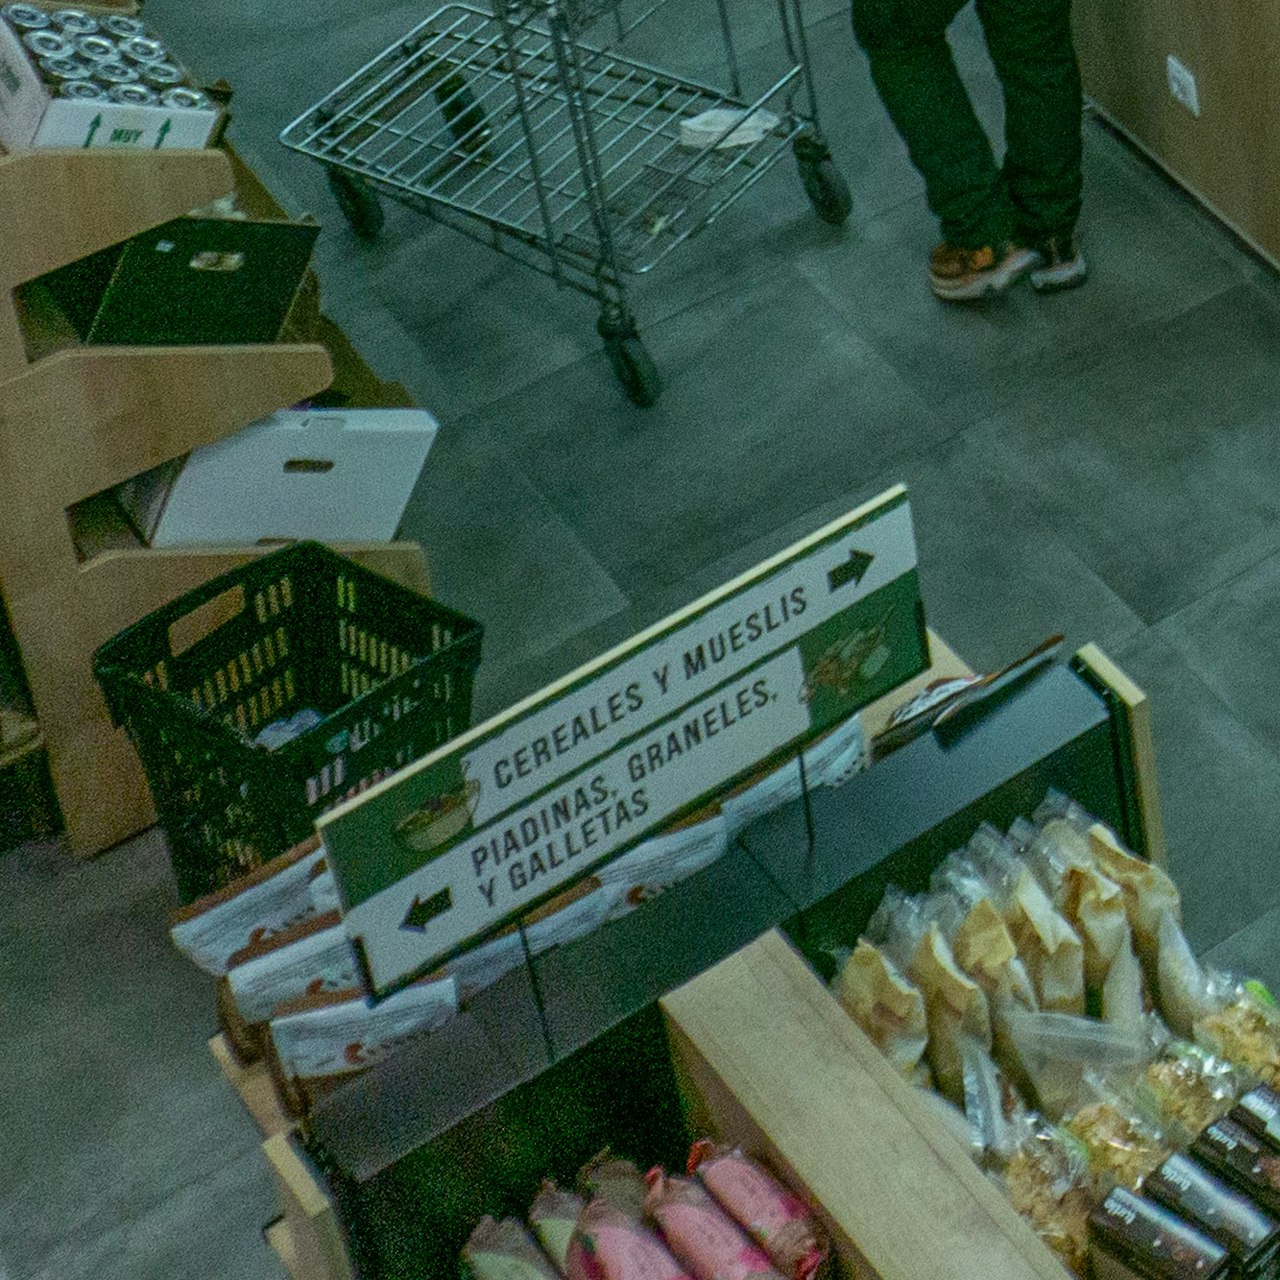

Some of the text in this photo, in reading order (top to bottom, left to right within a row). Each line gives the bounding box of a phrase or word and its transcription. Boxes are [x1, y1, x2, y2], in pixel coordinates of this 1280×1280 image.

[470, 678, 778, 875] PIADINAS, GRANELES,
[493, 588, 808, 790] CEREALES Y MUESLIS
[477, 790, 649, 908] Y GALLETAS
